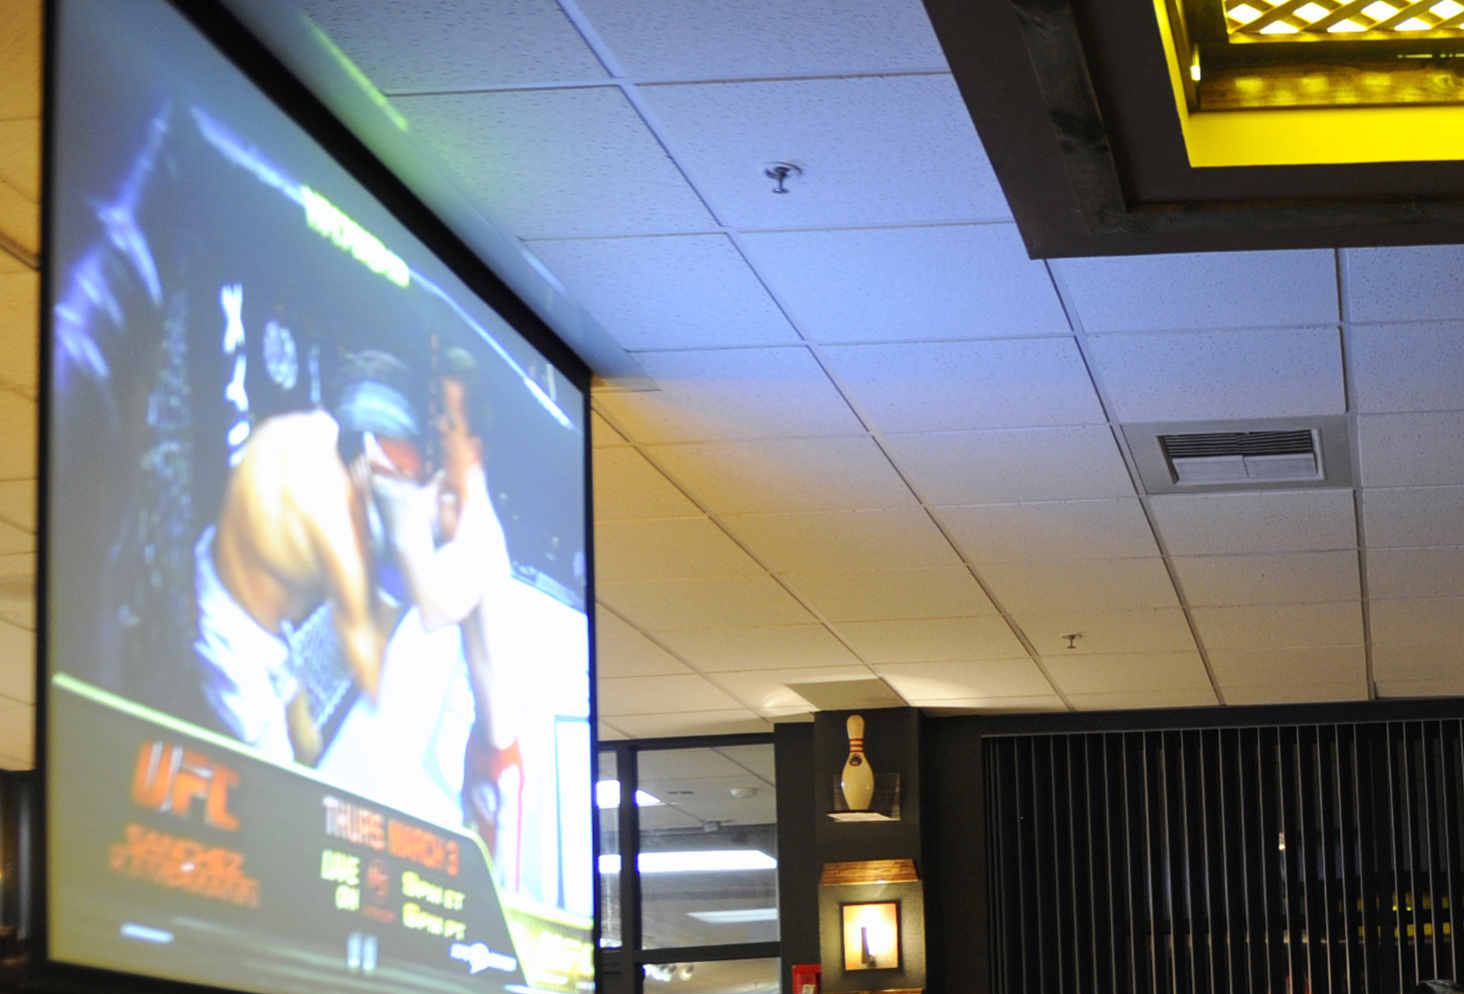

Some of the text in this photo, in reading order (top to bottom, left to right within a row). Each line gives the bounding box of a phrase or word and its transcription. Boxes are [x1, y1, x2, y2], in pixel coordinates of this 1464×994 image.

[133, 739, 241, 831] UFC
[322, 796, 385, 851] THURS
[321, 849, 360, 886] LIVE
[335, 885, 360, 911] ON
